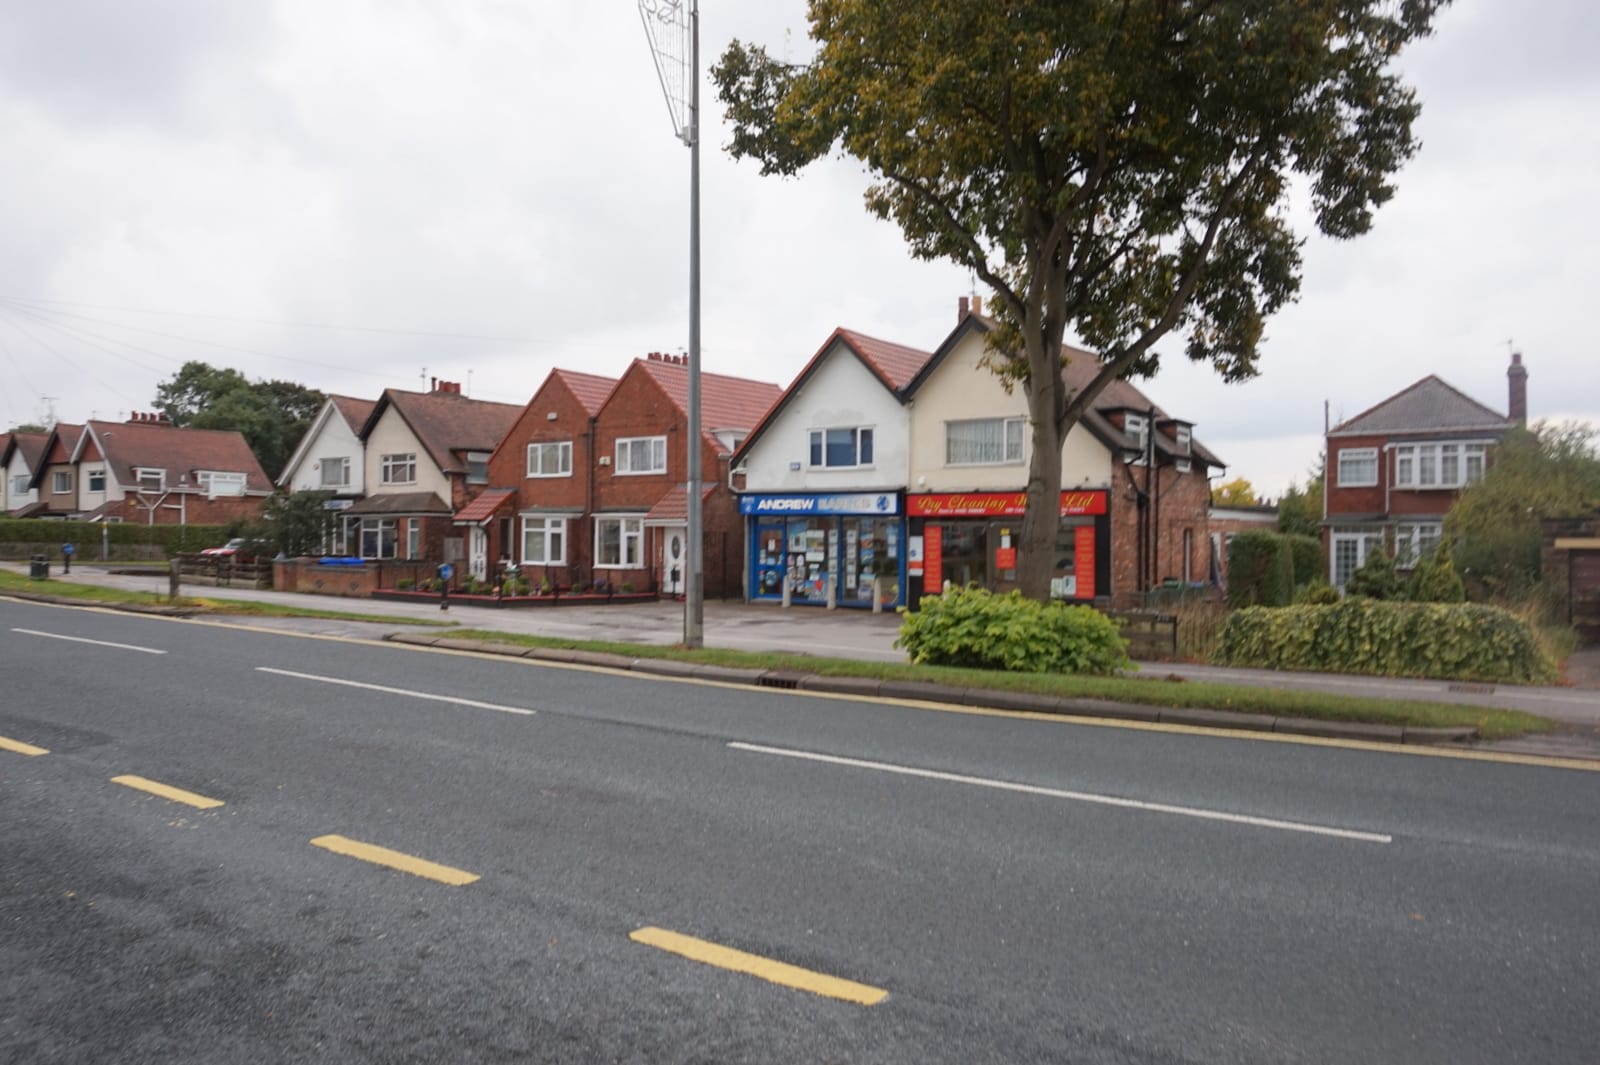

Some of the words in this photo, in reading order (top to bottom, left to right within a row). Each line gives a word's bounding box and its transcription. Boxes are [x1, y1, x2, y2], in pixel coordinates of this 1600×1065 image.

[757, 499, 815, 511] ANDREW
[917, 494, 943, 513] Dry
[947, 494, 1008, 511] Cleaning
